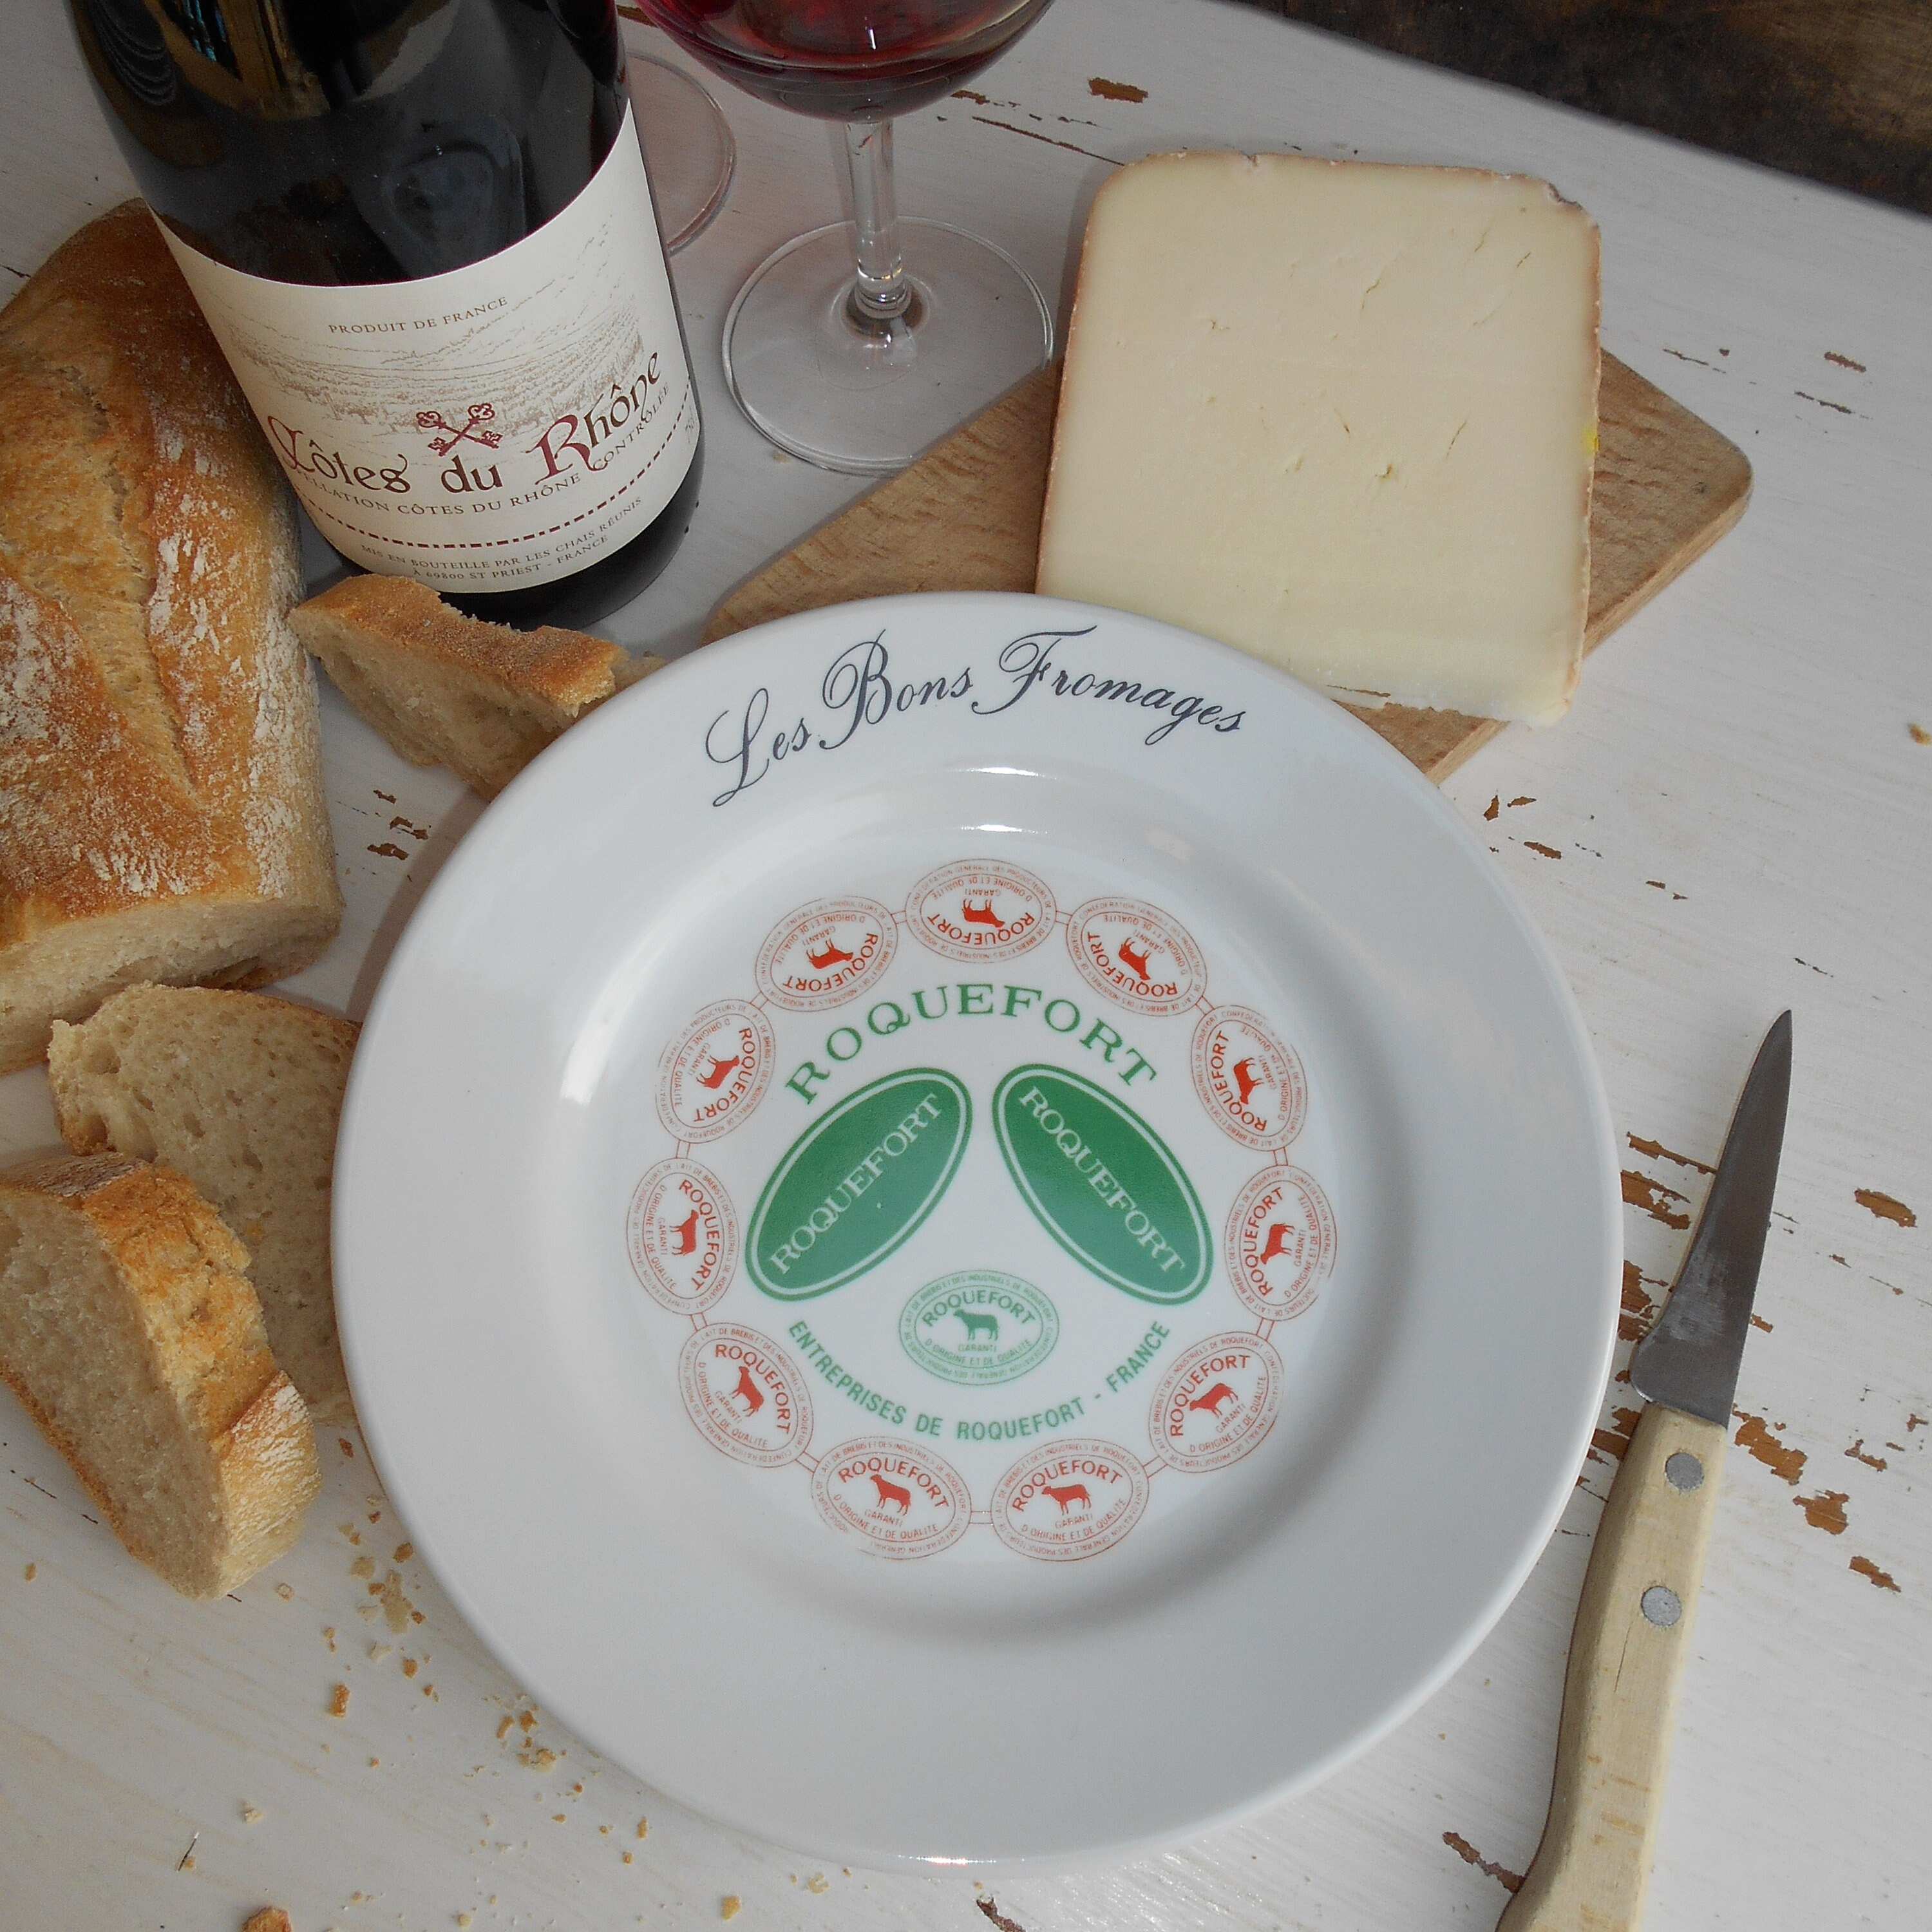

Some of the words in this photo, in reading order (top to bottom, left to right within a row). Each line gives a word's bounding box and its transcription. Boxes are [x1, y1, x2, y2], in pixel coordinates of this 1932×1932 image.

[328, 323, 406, 334] PRODUIT
[413, 319, 437, 330] DE
[442, 296, 508, 325] FRANCE
[267, 415, 411, 493] Côtes
[440, 455, 503, 493] du
[525, 352, 661, 485] Rhône
[397, 499, 464, 515] CÔTES
[472, 501, 501, 513] DU
[510, 473, 581, 506] RHÔNE
[361, 545, 384, 558] MIS
[388, 554, 406, 564] EN
[411, 559, 489, 569] BOUTEILLE
[495, 558, 520, 567] PAR
[526, 549, 551, 562] LES
[556, 530, 595, 552] CHAIS
[426, 571, 464, 580] 69800
[469, 571, 486, 580] ST
[493, 563, 541, 578] PRIEST
[557, 535, 609, 564] FRANCE
[706, 688, 811, 808] Les
[820, 629, 974, 750] Bons
[971, 625, 1248, 746] Fromages
[965, 888, 1001, 896] GARANTI
[802, 925, 835, 946] GARANTI
[927, 912, 1036, 946] ROQUEFORT
[1133, 929, 1164, 954] GARANTI
[782, 933, 879, 992] ROQUEFORT
[1086, 931, 1178, 998] ROQUEFORT
[687, 1043, 710, 1075] GARANTI
[784, 983, 1157, 1105] ROQUEFORT
[693, 1027, 756, 1122] ROQUEFORT
[1209, 1030, 1267, 1132] ROQUEFORT
[1258, 1055, 1277, 1090] GARANTI
[770, 1093, 942, 1274] ROQUEFORT
[1018, 1086, 1186, 1273] ROQUEFORT
[658, 1217, 668, 1255] GARANTI
[678, 1179, 721, 1291] ROQUEFORT
[1243, 1186, 1283, 1296] ROQUEFORT
[1294, 1229, 1305, 1267] GARANTI
[922, 1289, 1036, 1327] ROQUEFORT
[715, 1343, 791, 1435] ROQUEFORT
[789, 1320, 907, 1425] ENTREPRISES
[914, 1414, 943, 1436] DE
[956, 1397, 1085, 1441] ROQUEFORT
[1106, 1321, 1170, 1392] FRANCE
[1169, 1354, 1251, 1437] ROQUEFORT
[714, 1390, 742, 1423] GARANTI
[1216, 1403, 1245, 1433] GARANTI
[837, 1456, 949, 1508] ROQUEFORT
[1011, 1459, 1122, 1512] ROQUEFORT
[864, 1509, 902, 1526] GARANTI
[1055, 1513, 1093, 1529] GARANTI
